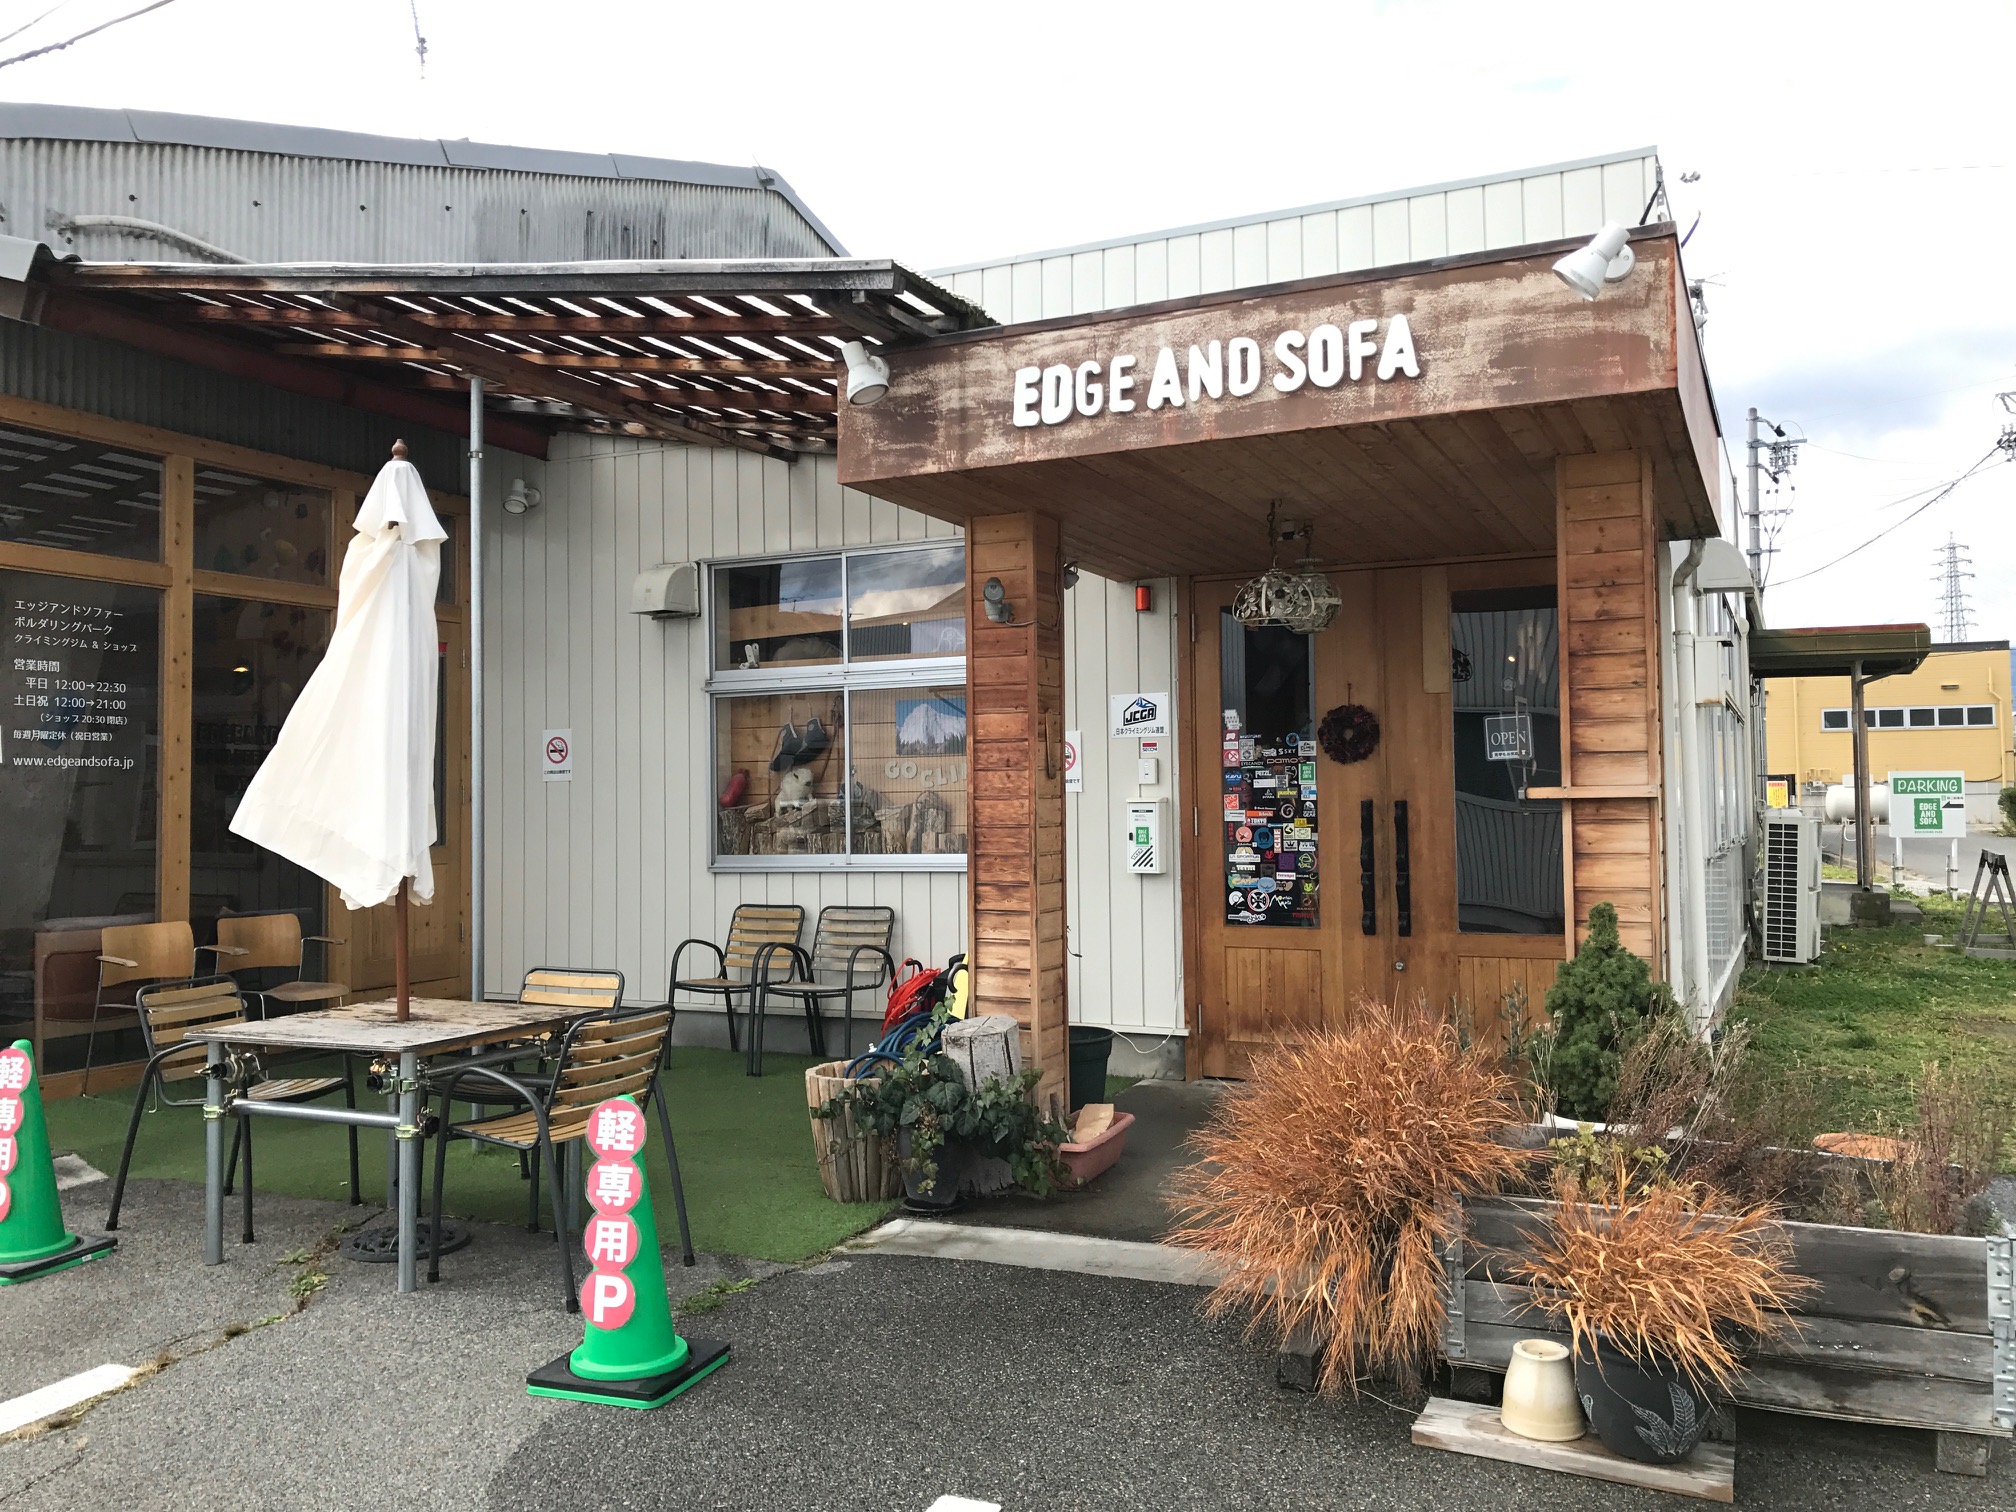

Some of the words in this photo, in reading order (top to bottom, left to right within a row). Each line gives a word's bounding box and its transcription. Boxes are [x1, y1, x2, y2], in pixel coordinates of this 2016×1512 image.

[1013, 354, 1137, 428] EDGE
[1147, 336, 1261, 411] AND
[1272, 314, 1420, 393] SOFA
[14, 600, 124, 619] エッジアンドソファー
[14, 634, 88, 648] クライミングジム
[14, 658, 60, 672] 営業時間
[26, 677, 48, 690] 平日
[14, 694, 48, 707] 土日祝
[1126, 708, 1154, 723] JCGA
[1490, 731, 1526, 746] OPEN
[12, 755, 134, 770] www.edgeandsofa.jp
[884, 760, 918, 779] GO
[1898, 780, 1958, 793] PARKING
[1919, 802, 1938, 810] EDGE
[1920, 810, 1936, 818] AND
